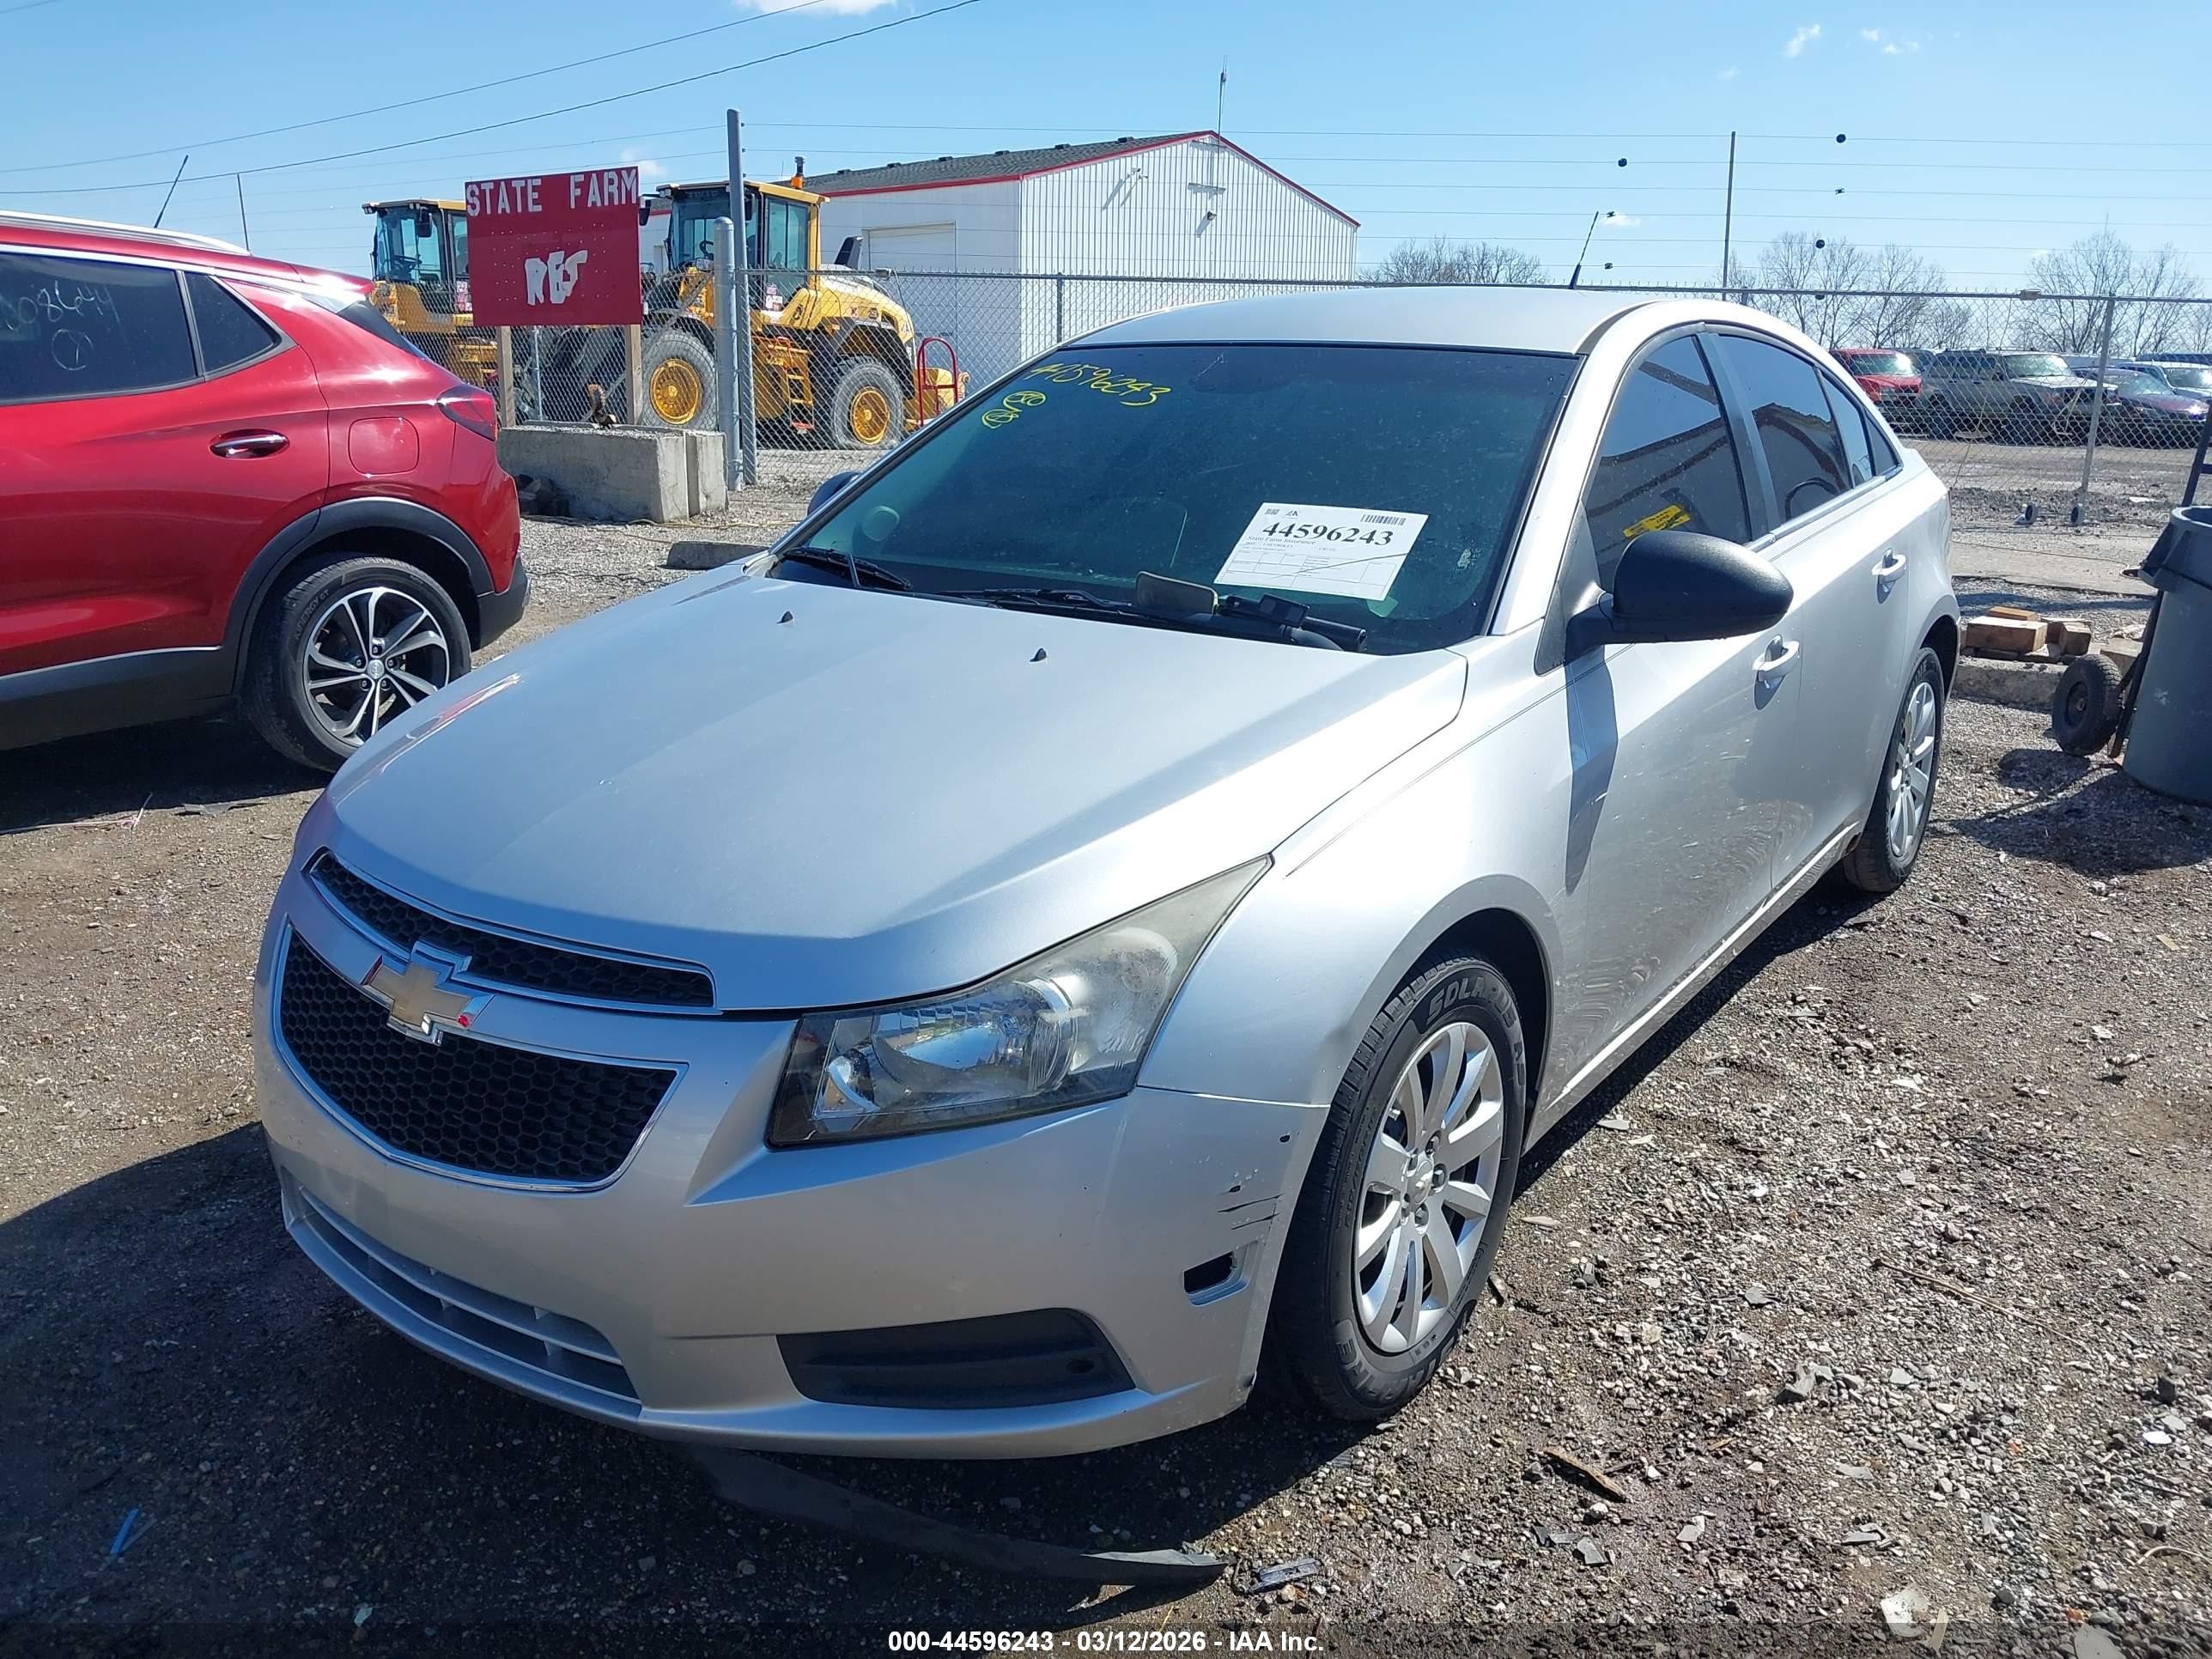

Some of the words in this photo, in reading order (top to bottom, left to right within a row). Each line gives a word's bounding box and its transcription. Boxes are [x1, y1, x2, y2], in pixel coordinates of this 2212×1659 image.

[466, 179, 542, 216] STATE
[569, 169, 638, 209] FARM
[1262, 522, 1394, 546] 44596243
